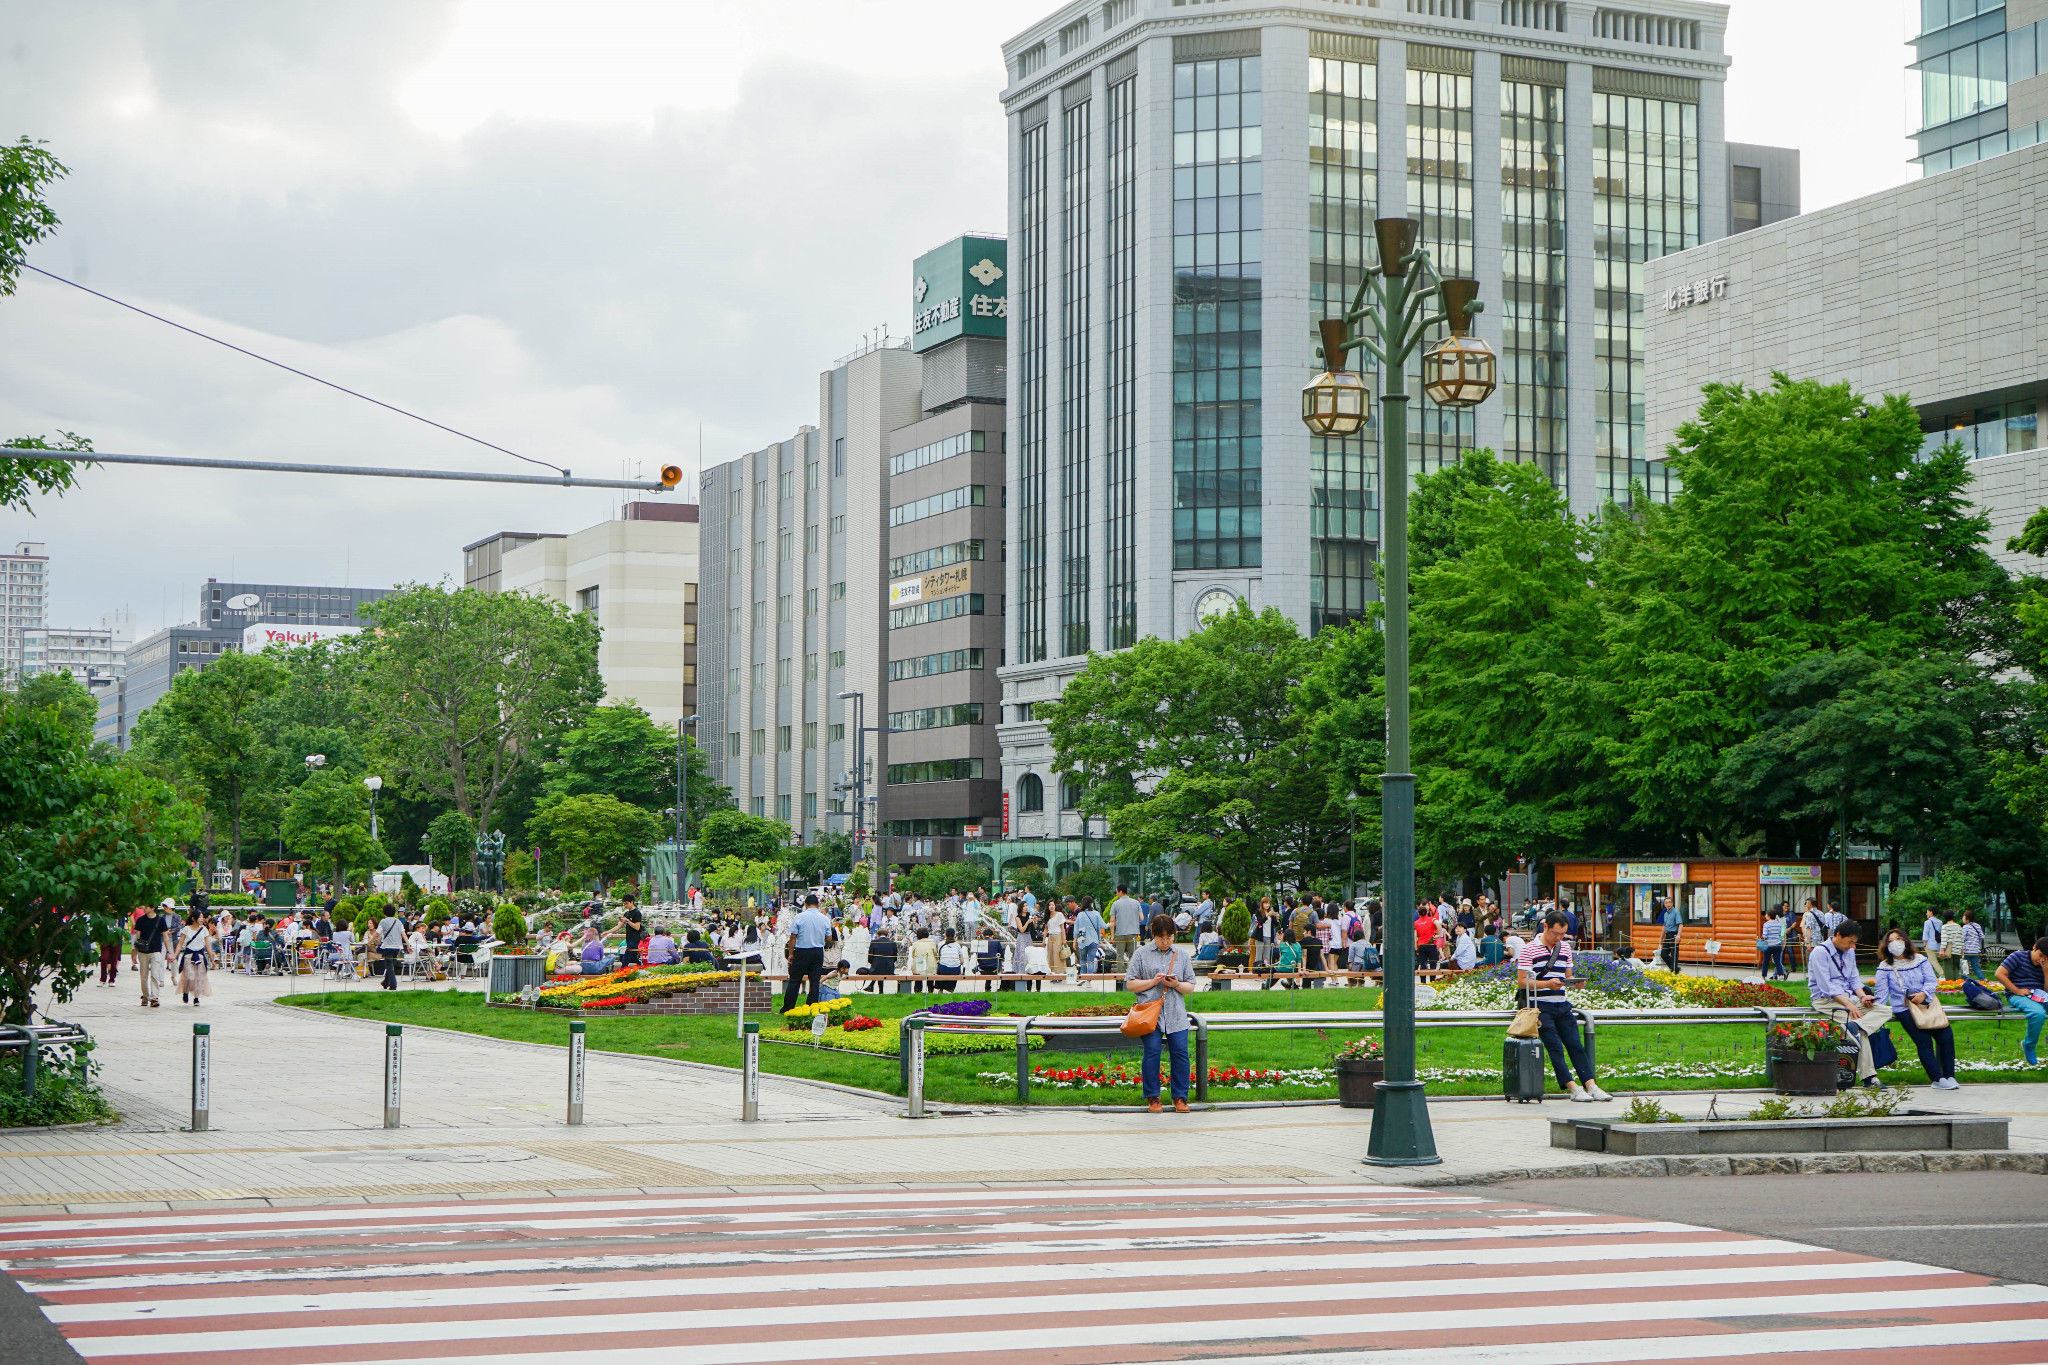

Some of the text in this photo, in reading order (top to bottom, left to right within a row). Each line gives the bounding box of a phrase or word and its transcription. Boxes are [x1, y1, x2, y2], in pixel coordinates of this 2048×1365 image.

[1663, 274, 1727, 311] 北洋銀行
[915, 296, 961, 334] 住友不動産
[924, 567, 968, 589] シティタワー札幌
[265, 630, 319, 643] Yakult
